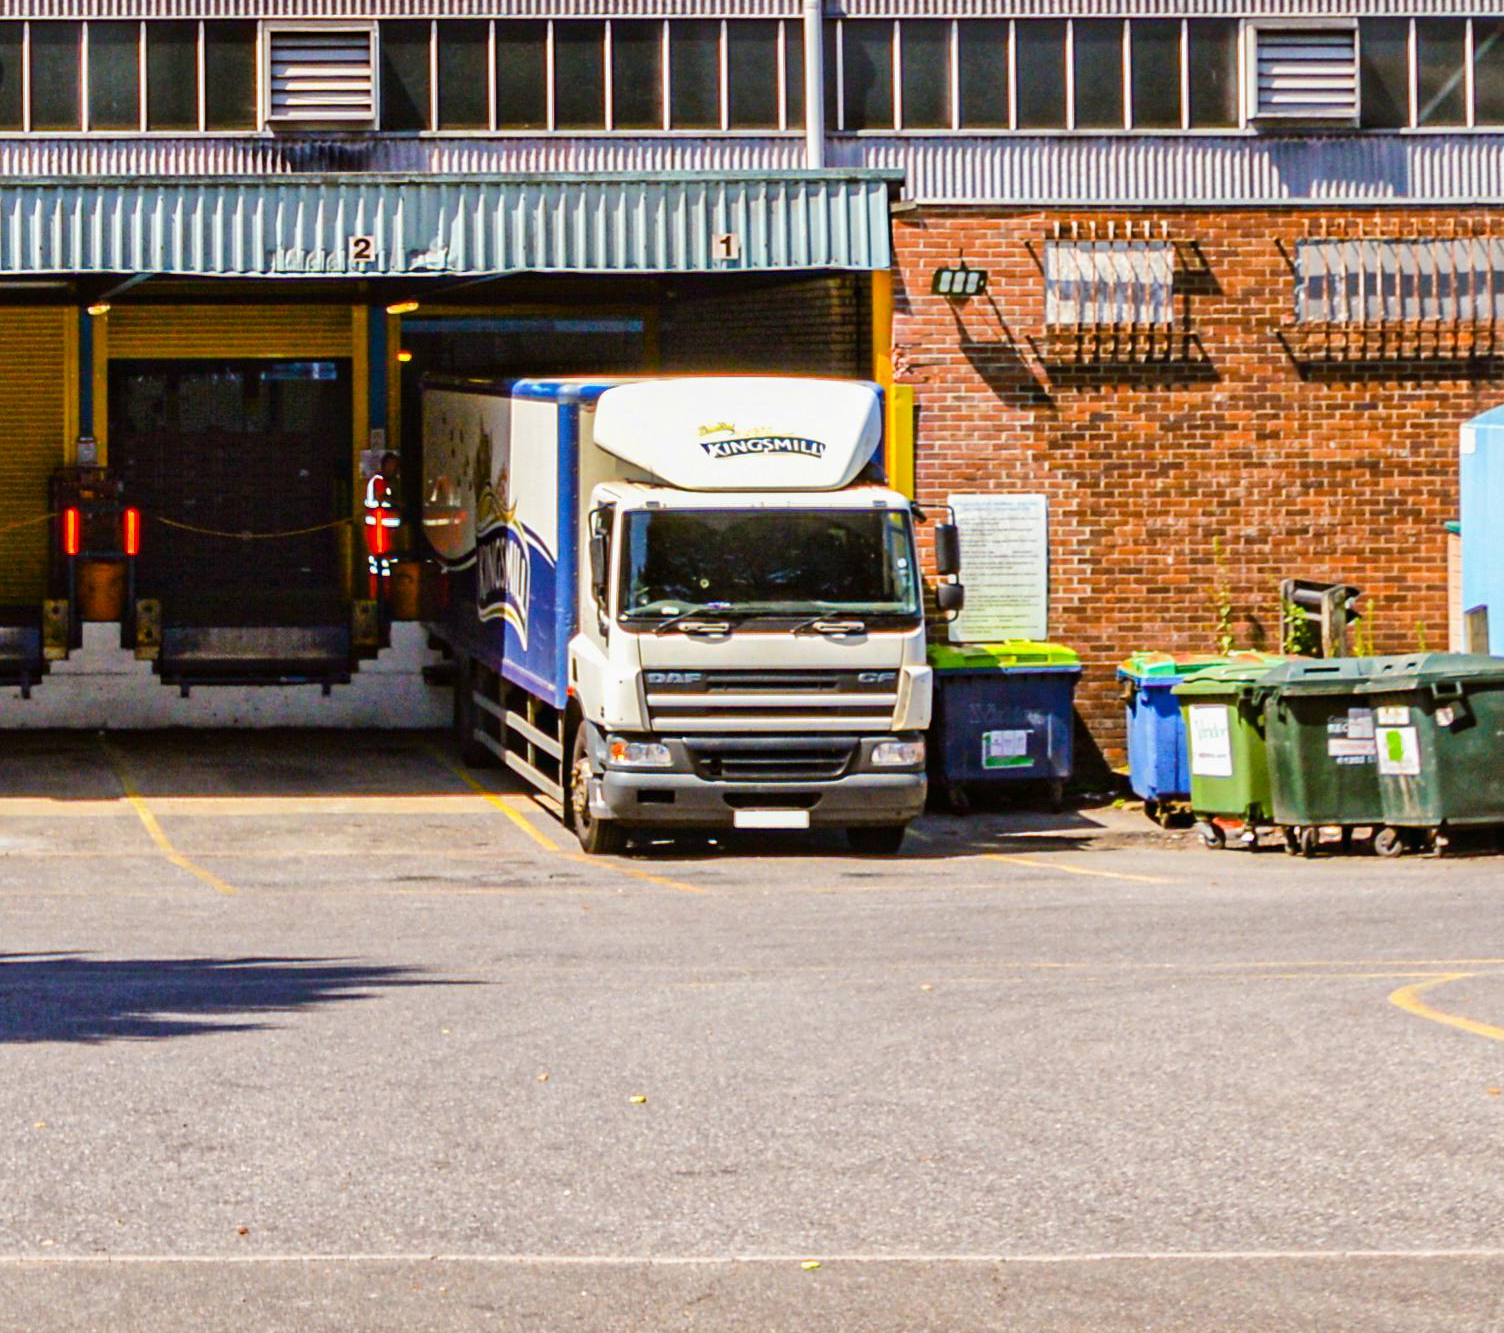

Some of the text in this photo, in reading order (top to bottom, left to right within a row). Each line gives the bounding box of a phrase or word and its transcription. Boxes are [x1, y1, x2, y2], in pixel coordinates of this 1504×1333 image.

[353, 238, 371, 259] 2
[719, 235, 731, 256] 1
[708, 438, 823, 456] KINGSMILL
[647, 673, 702, 683] DAF
[857, 672, 896, 683] CF
